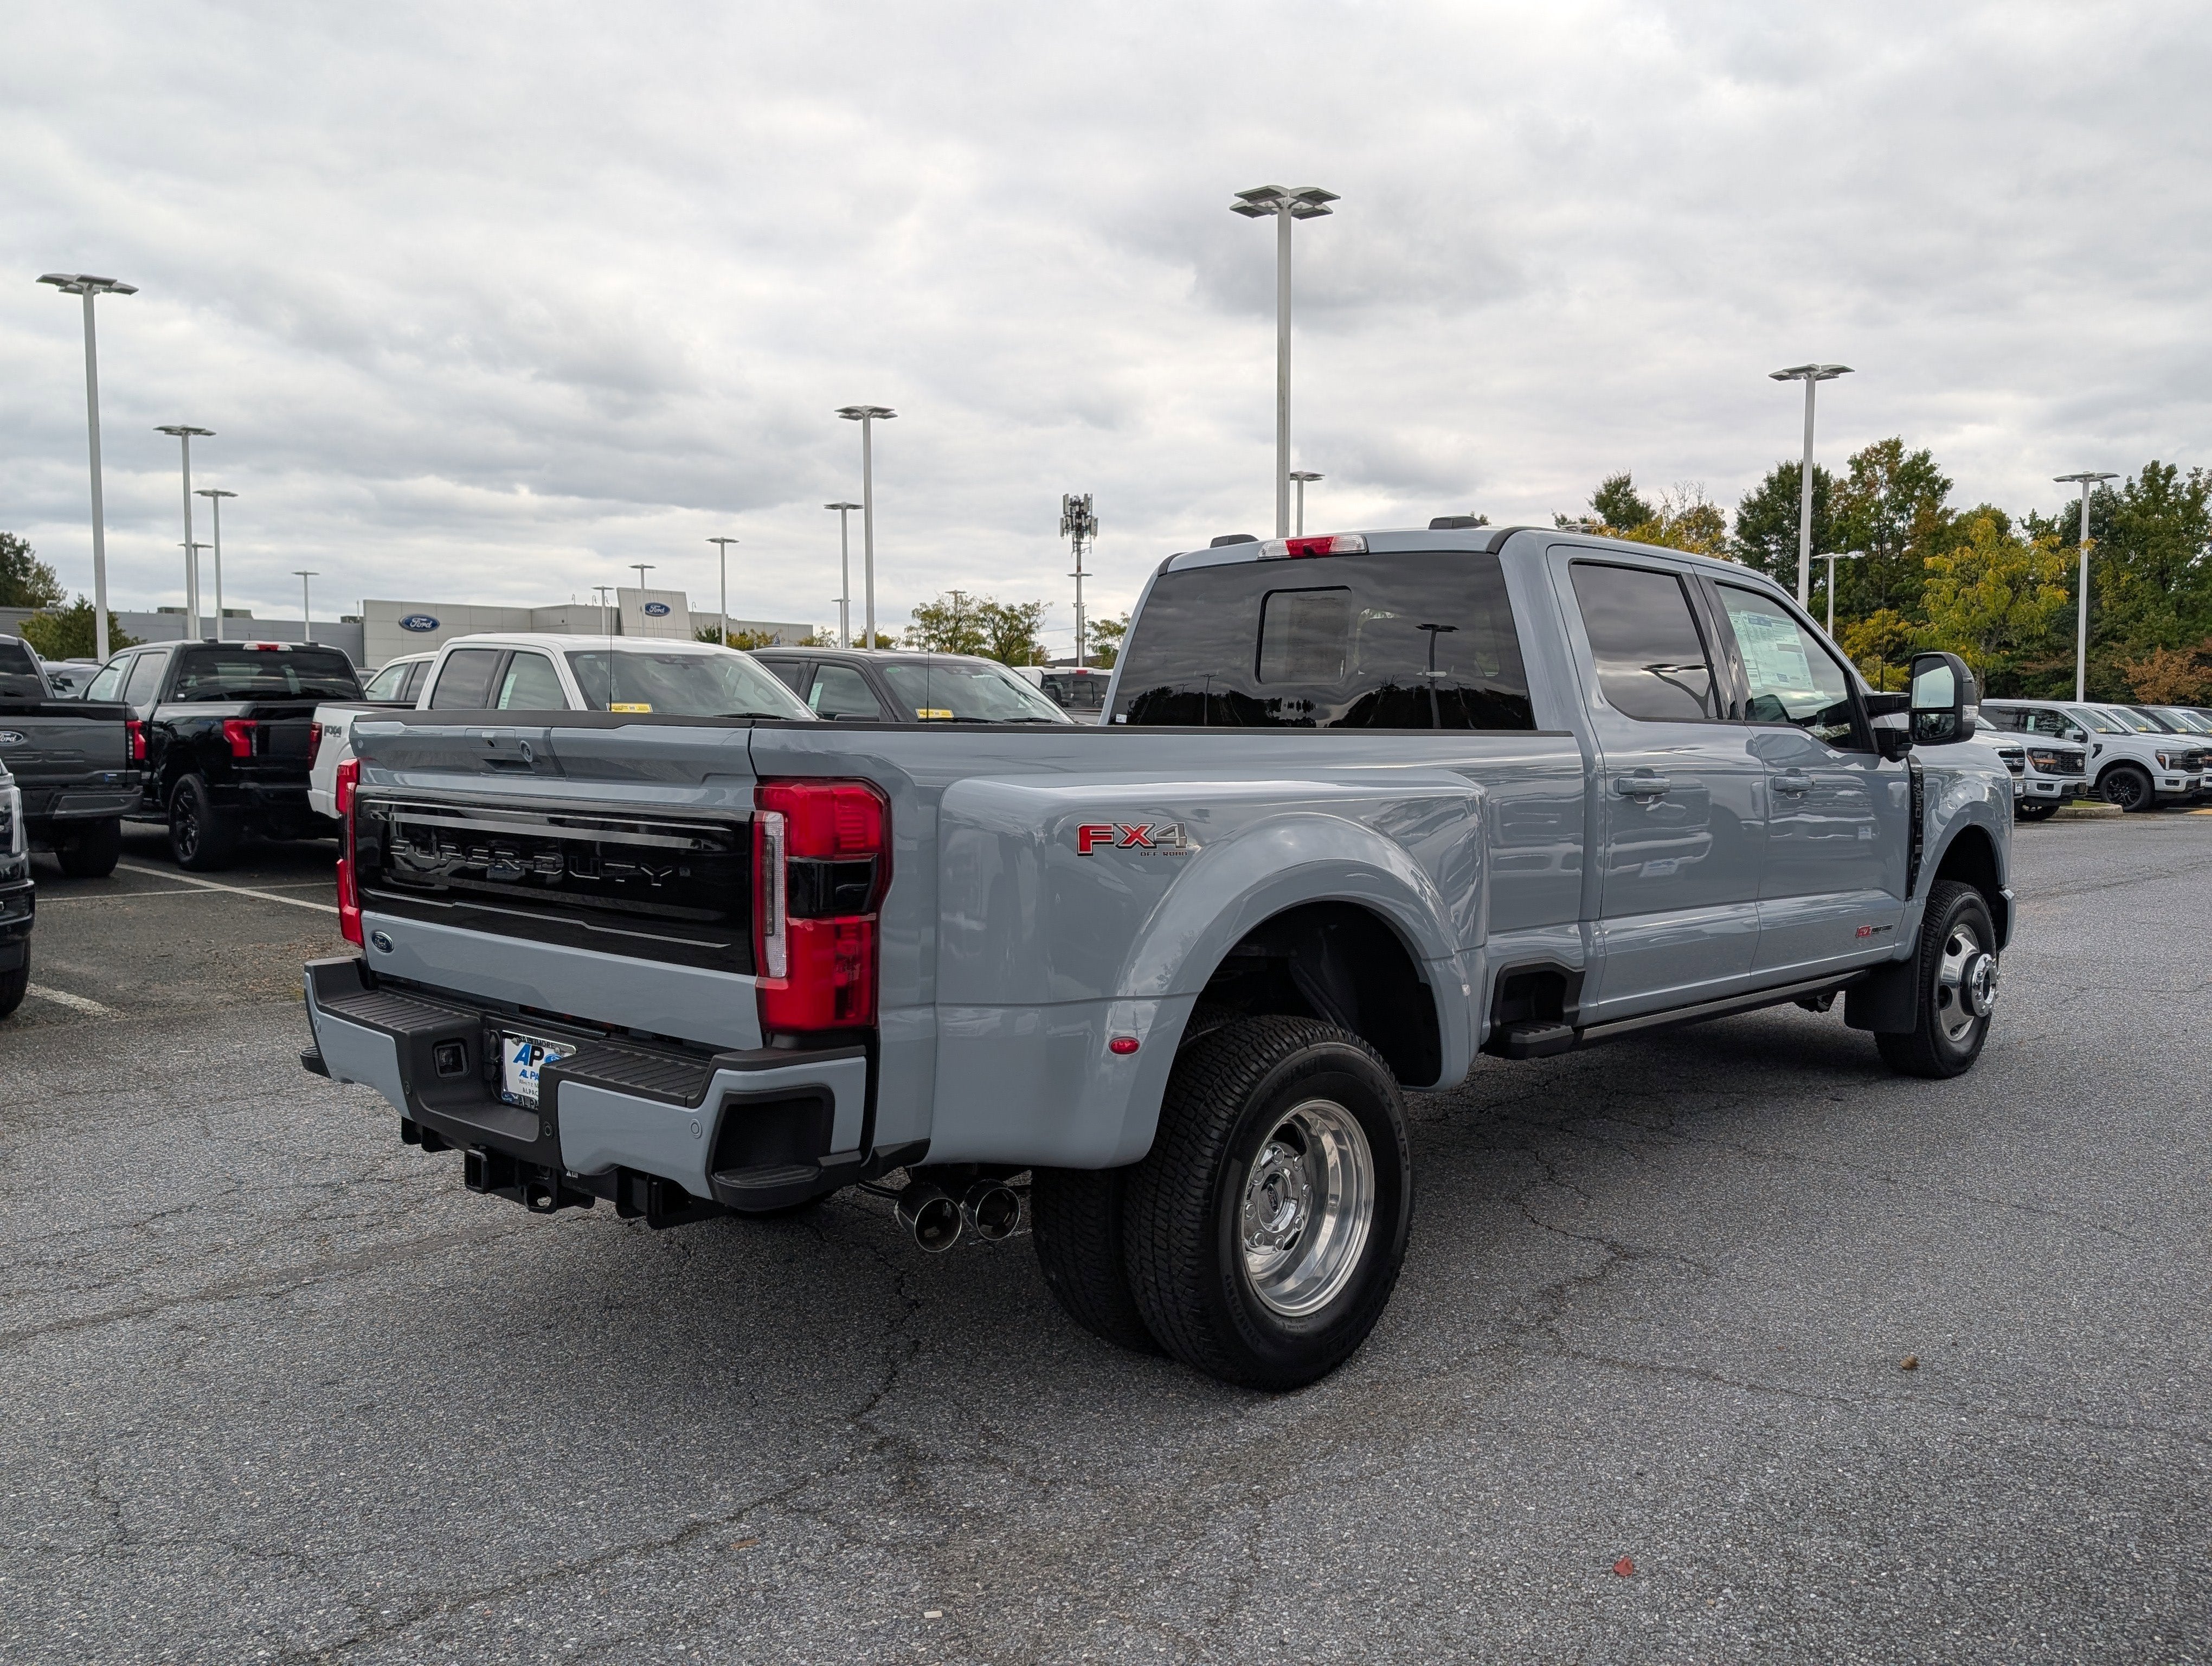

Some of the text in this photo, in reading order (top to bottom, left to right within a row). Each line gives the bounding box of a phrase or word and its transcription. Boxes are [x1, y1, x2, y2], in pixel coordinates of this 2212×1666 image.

[410, 618, 433, 628] Ford
[1076, 822, 1188, 857] FX4
[390, 837, 673, 886] SUPER DUTY
[513, 1043, 544, 1067] AP
[519, 1069, 528, 1079] AL
